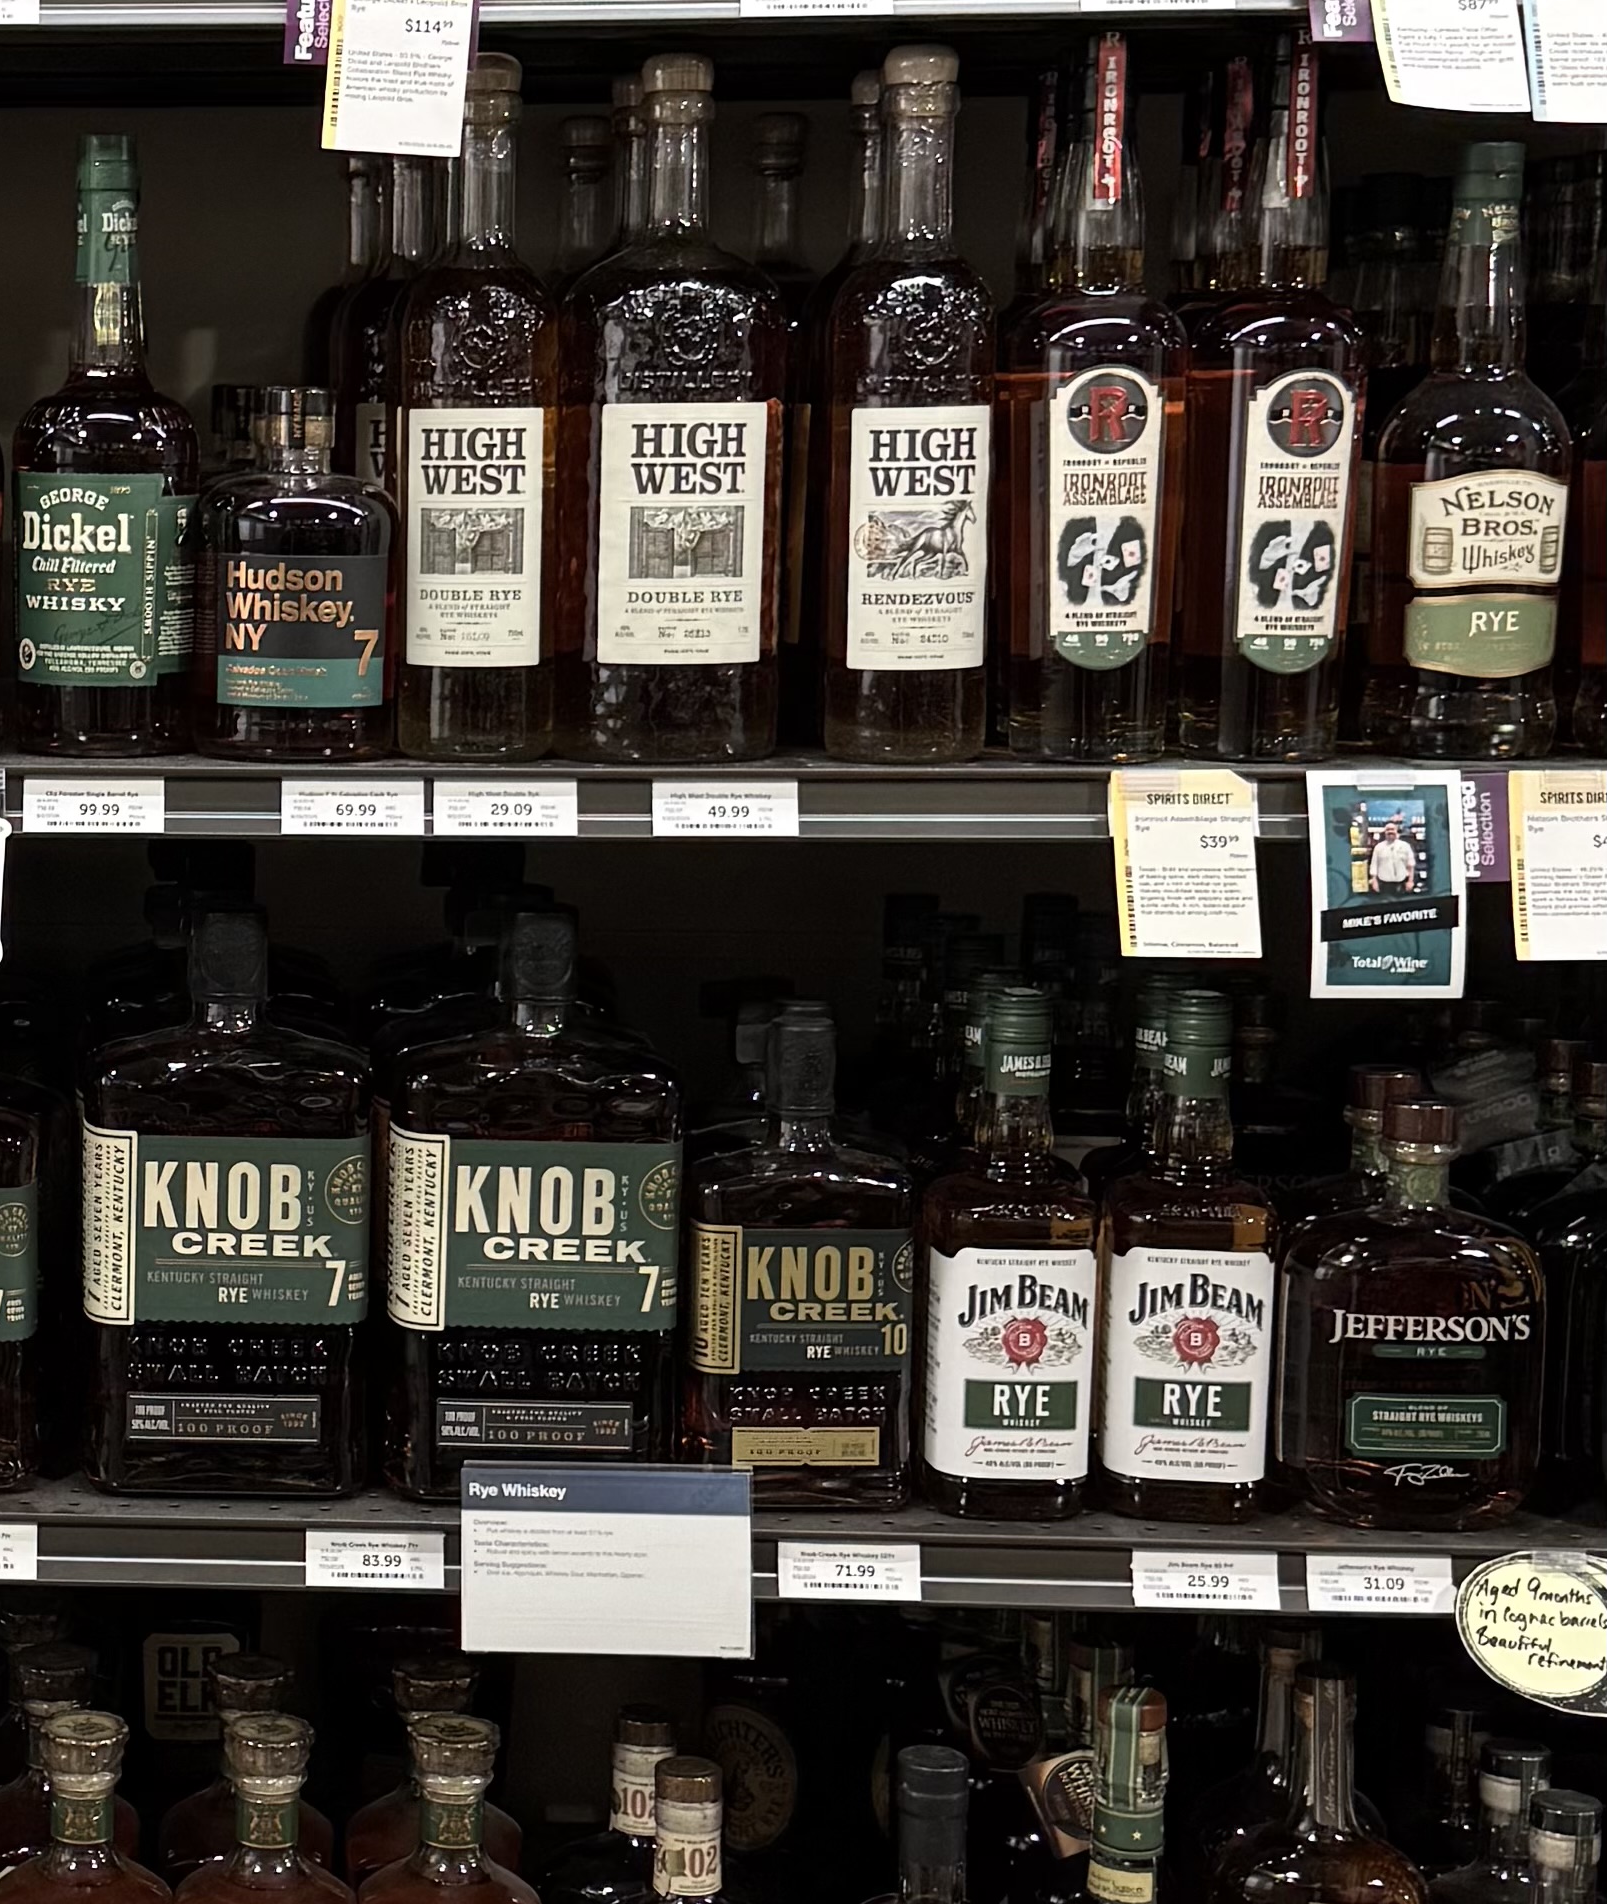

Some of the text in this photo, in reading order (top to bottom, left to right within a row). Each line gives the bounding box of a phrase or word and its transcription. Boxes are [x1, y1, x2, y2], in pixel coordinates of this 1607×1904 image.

[631, 423, 747, 459] HIGH
[868, 428, 977, 463] HIGH
[631, 462, 746, 495] WEST
[870, 465, 976, 498] WEST
[1439, 490, 1554, 518] NELSON
[226, 561, 343, 592] Hudson
[627, 590, 743, 604] DOUBLE RYE
[861, 591, 976, 607] RENDEZVOUS
[1470, 610, 1519, 635] RYE
[225, 625, 262, 651] NY
[353, 629, 380, 676] 7
[79, 803, 120, 816] 99.99
[335, 804, 377, 817] 69.99
[1342, 908, 1436, 929] MIKE'S FAVORITE
[144, 1161, 301, 1231] KNOB
[171, 1233, 334, 1258] CREEK
[326, 1261, 346, 1306] 7
[747, 1246, 875, 1302] KNOB
[769, 1302, 904, 1322] CREEK
[883, 1324, 907, 1355] 10
[1329, 1309, 1530, 1344] JEFFERSON'S
[993, 1385, 1050, 1418] RYE
[469, 1482, 566, 1500] Rye Whiskey
[363, 1555, 402, 1568] 83.99
[835, 1564, 876, 1578] 71.99
[1187, 1574, 1229, 1588] 25.99
[1475, 1576, 1593, 1605] Aged 9 months
[1479, 1608, 1498, 1622] in
[1527, 1651, 1606, 1672] refinement
